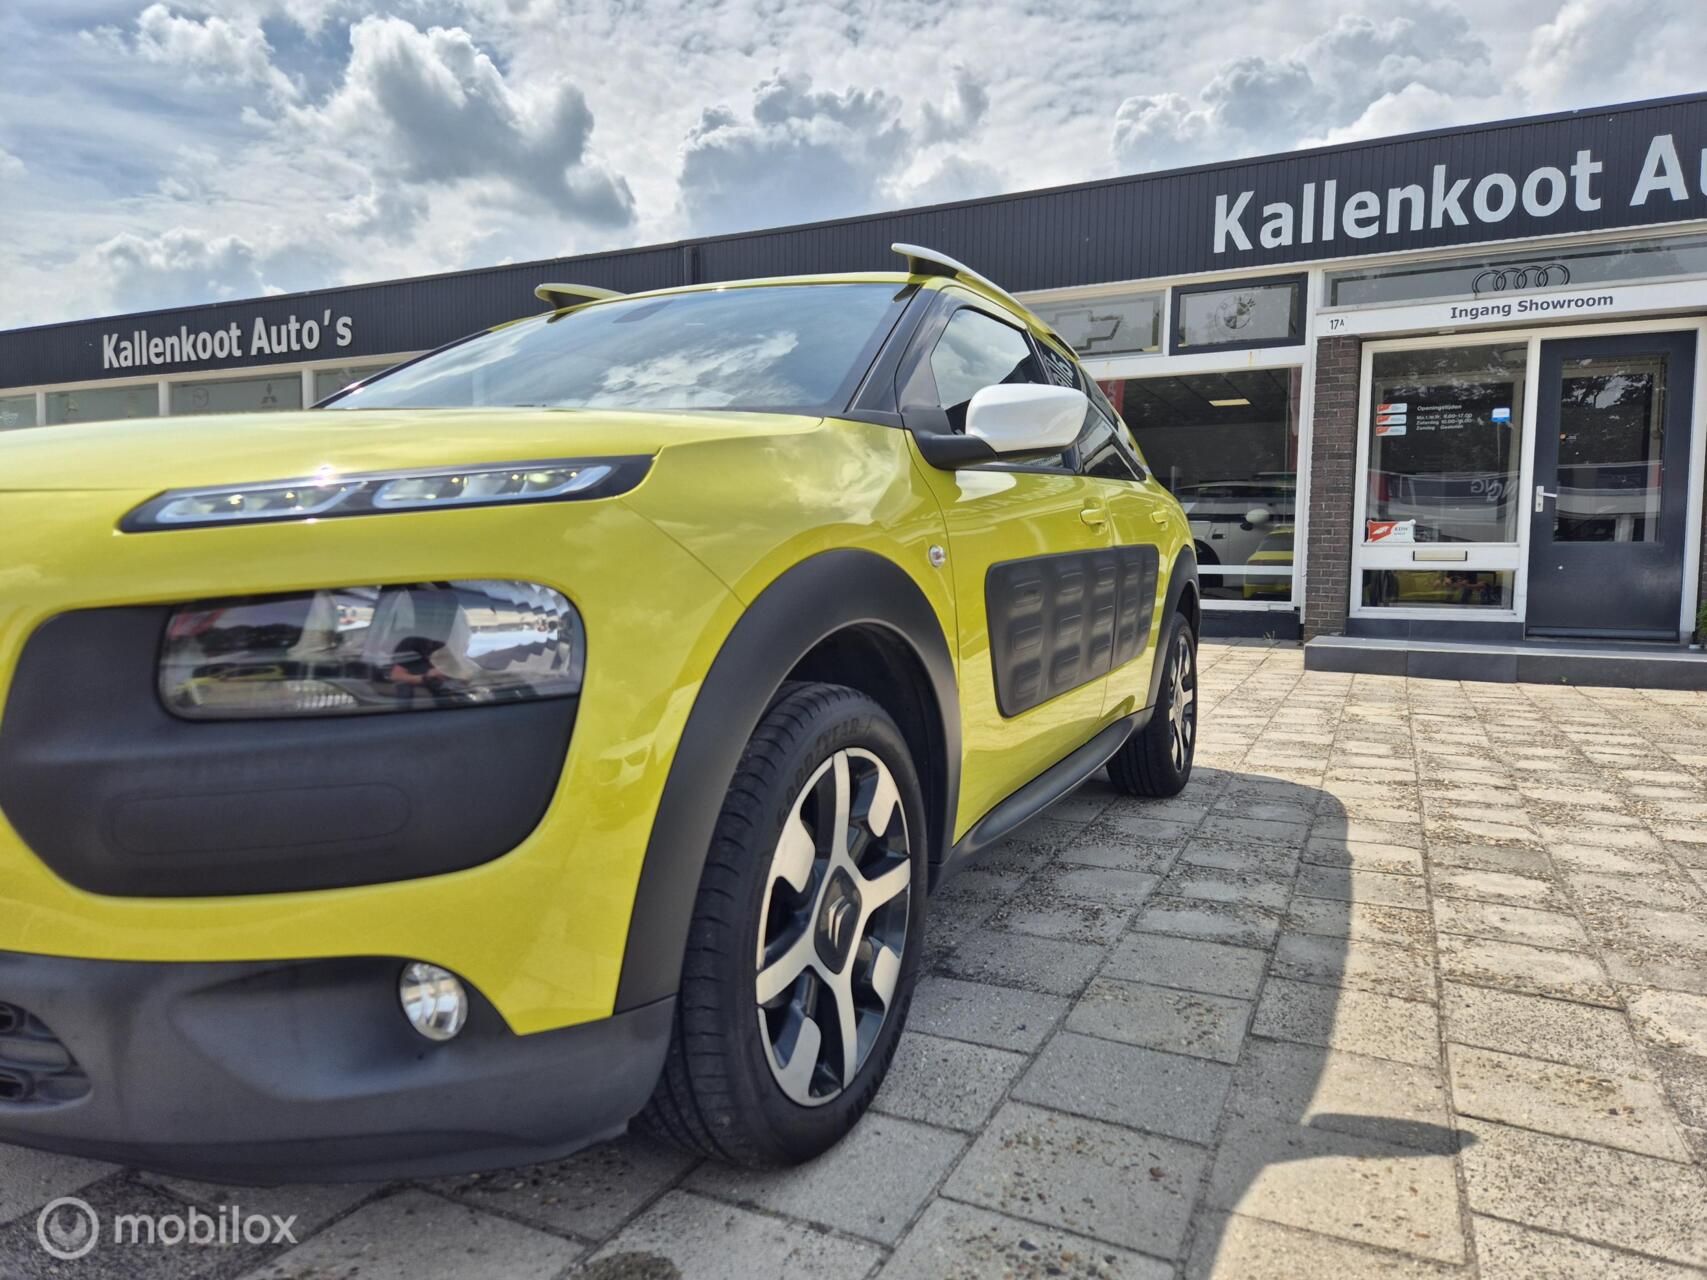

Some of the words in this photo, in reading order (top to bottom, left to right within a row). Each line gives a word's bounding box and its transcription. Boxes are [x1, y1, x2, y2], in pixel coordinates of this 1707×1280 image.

[1214, 150, 1603, 253] Kallenkoot
[1450, 304, 1512, 320] Ingang
[1517, 295, 1614, 312] Showroom
[103, 322, 242, 368] Kallenkoot
[250, 309, 352, 355] Auto's
